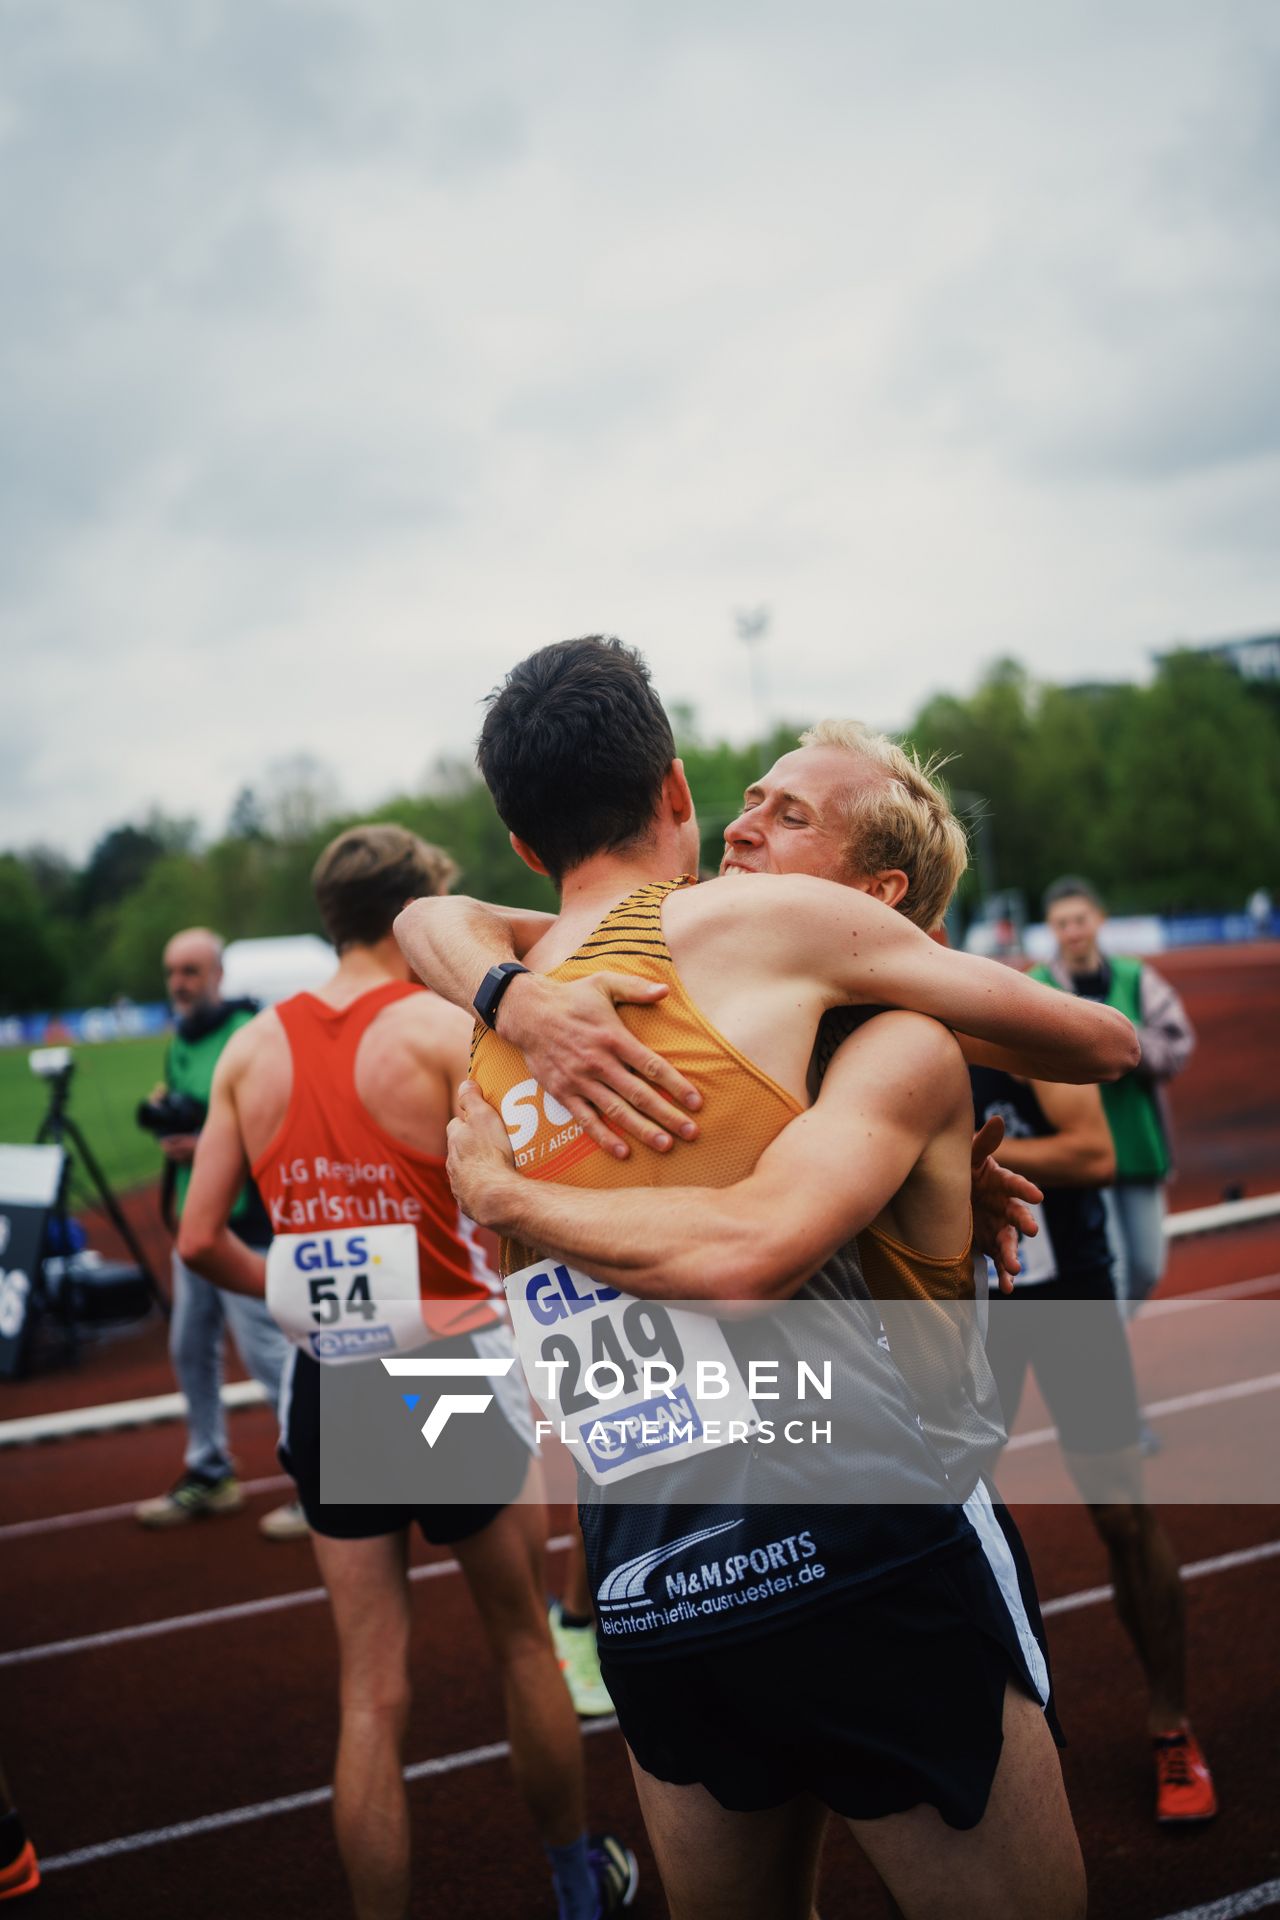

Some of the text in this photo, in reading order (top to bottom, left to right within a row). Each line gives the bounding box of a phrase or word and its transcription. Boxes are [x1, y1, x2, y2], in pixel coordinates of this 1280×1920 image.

[281, 1157, 396, 1186] LG Region
[270, 1189, 422, 1228] Karlsruhe
[308, 1274, 377, 1327] 54
[540, 1300, 685, 1416] 249
[665, 1530, 817, 1600] M&M SPORTS
[601, 1562, 826, 1635] leichtathletik-ausruester.de
